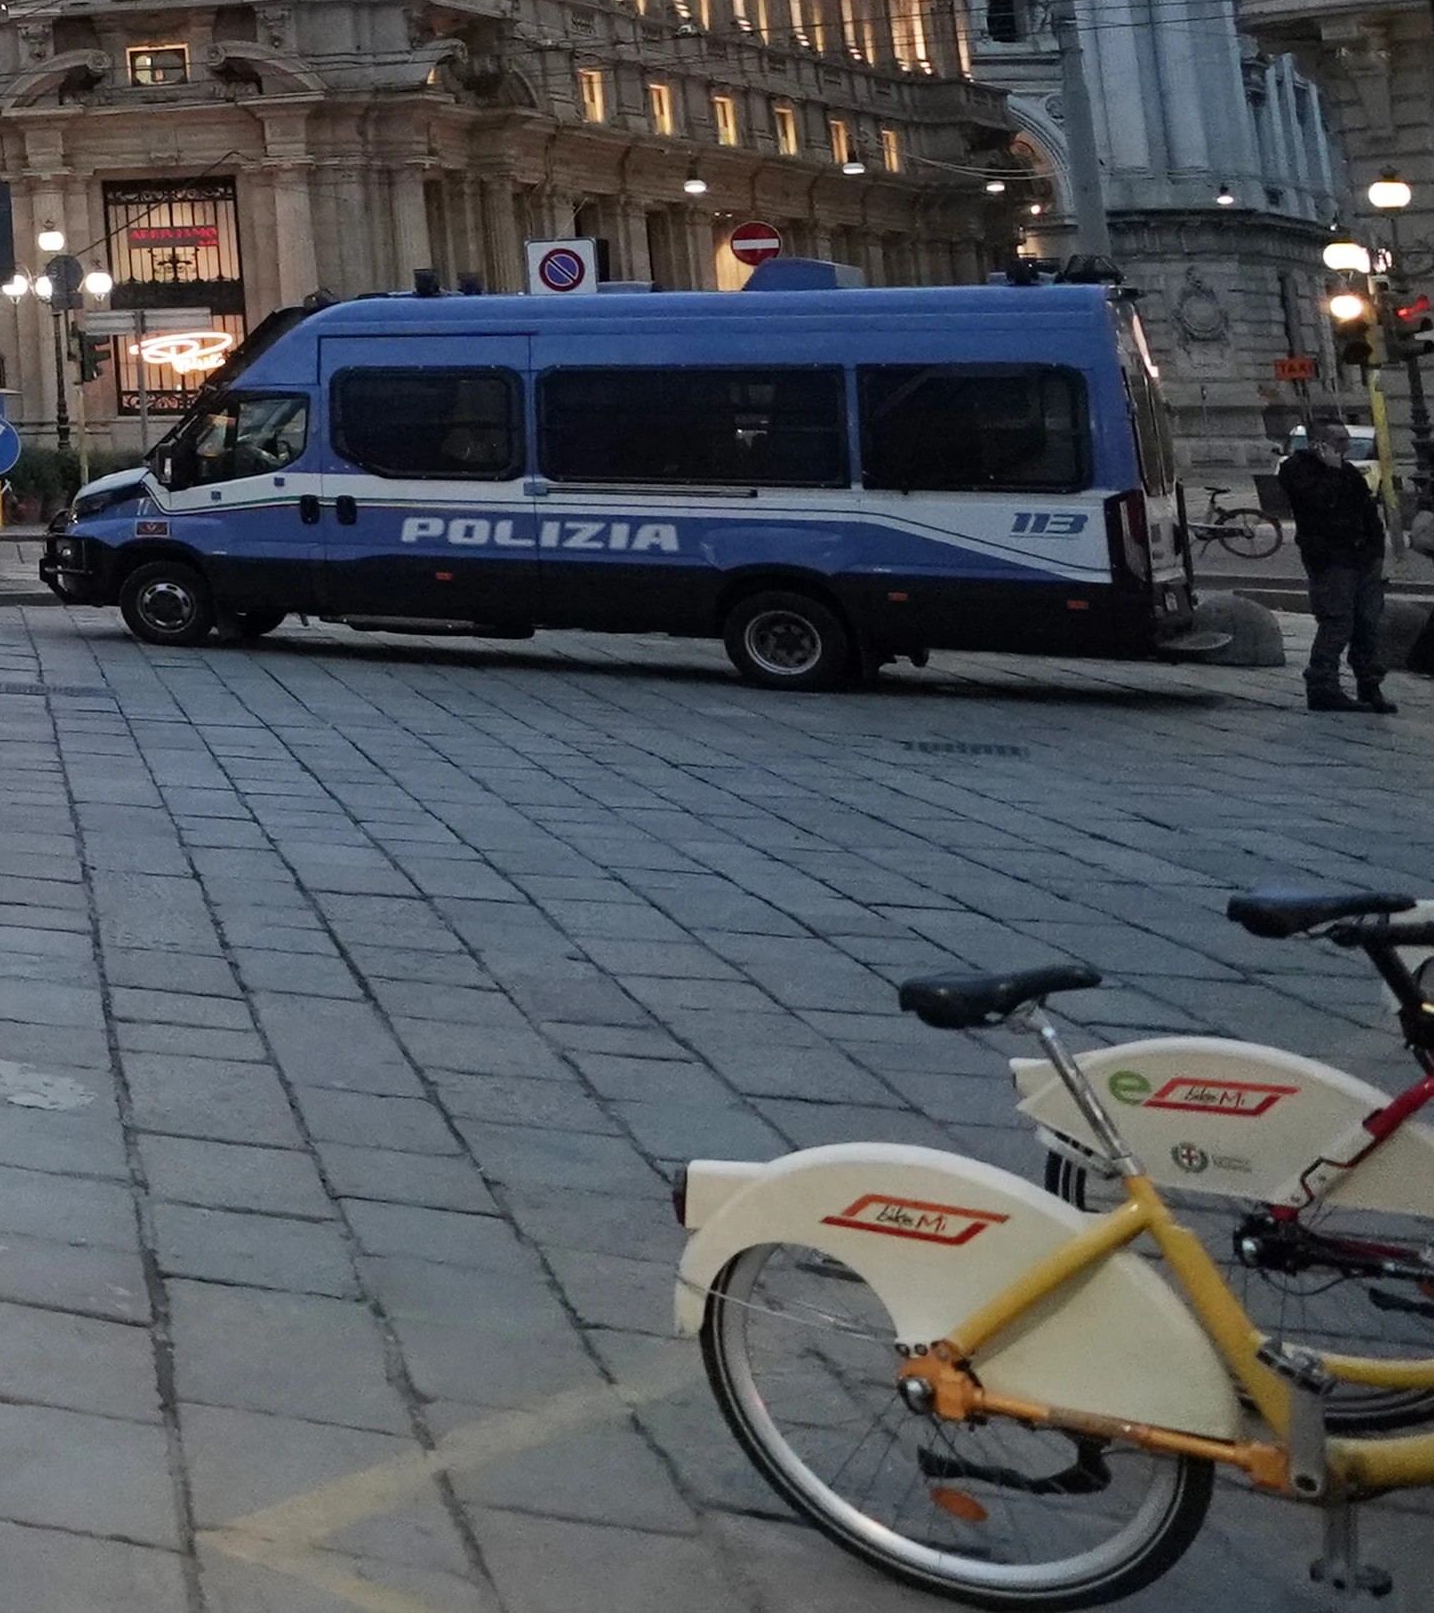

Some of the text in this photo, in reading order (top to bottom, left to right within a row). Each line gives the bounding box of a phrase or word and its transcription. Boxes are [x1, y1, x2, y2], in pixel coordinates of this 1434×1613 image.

[1279, 362, 1313, 375] TAXI
[400, 516, 680, 553] POLIZIA
[1010, 512, 1089, 535] 113
[1108, 1070, 1152, 1106] e
